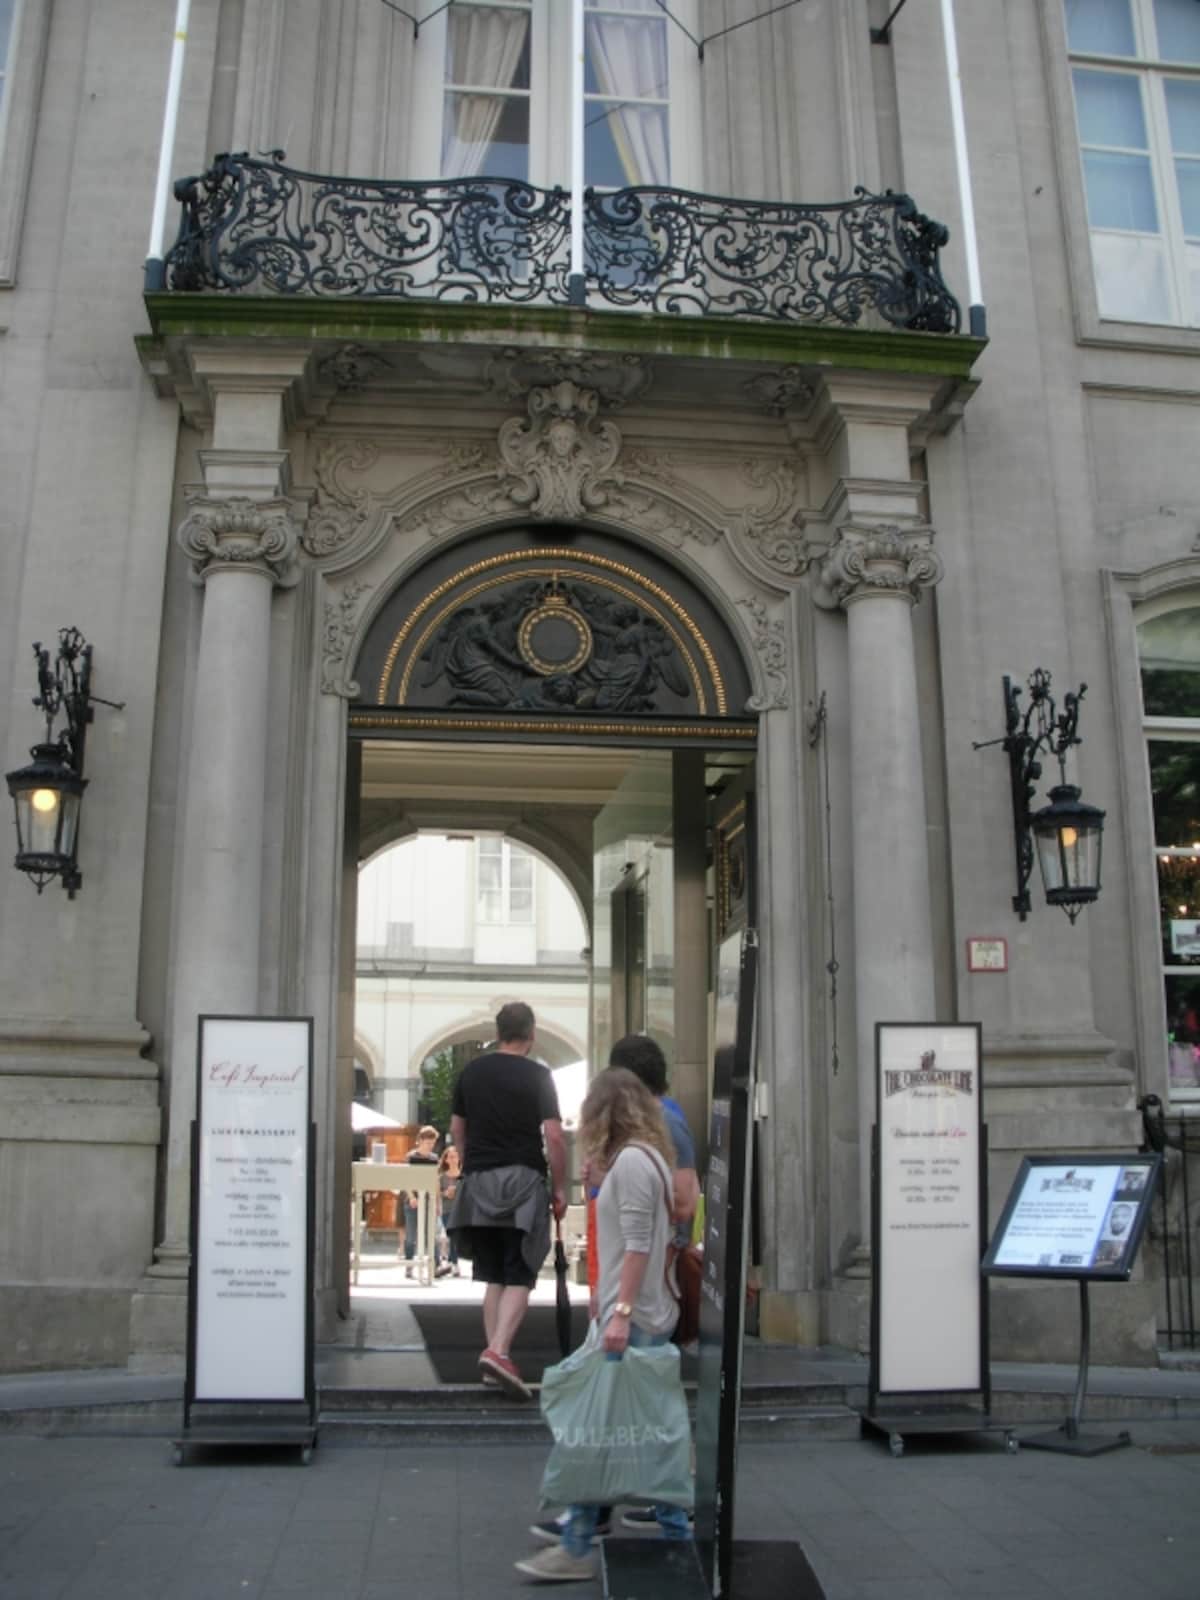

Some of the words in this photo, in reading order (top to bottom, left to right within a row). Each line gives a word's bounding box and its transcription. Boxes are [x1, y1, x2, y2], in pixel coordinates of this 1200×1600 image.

[885, 1070, 903, 1098] THE
[904, 1070, 952, 1088] CHOCOLATE
[954, 1070, 973, 1096] LINE
